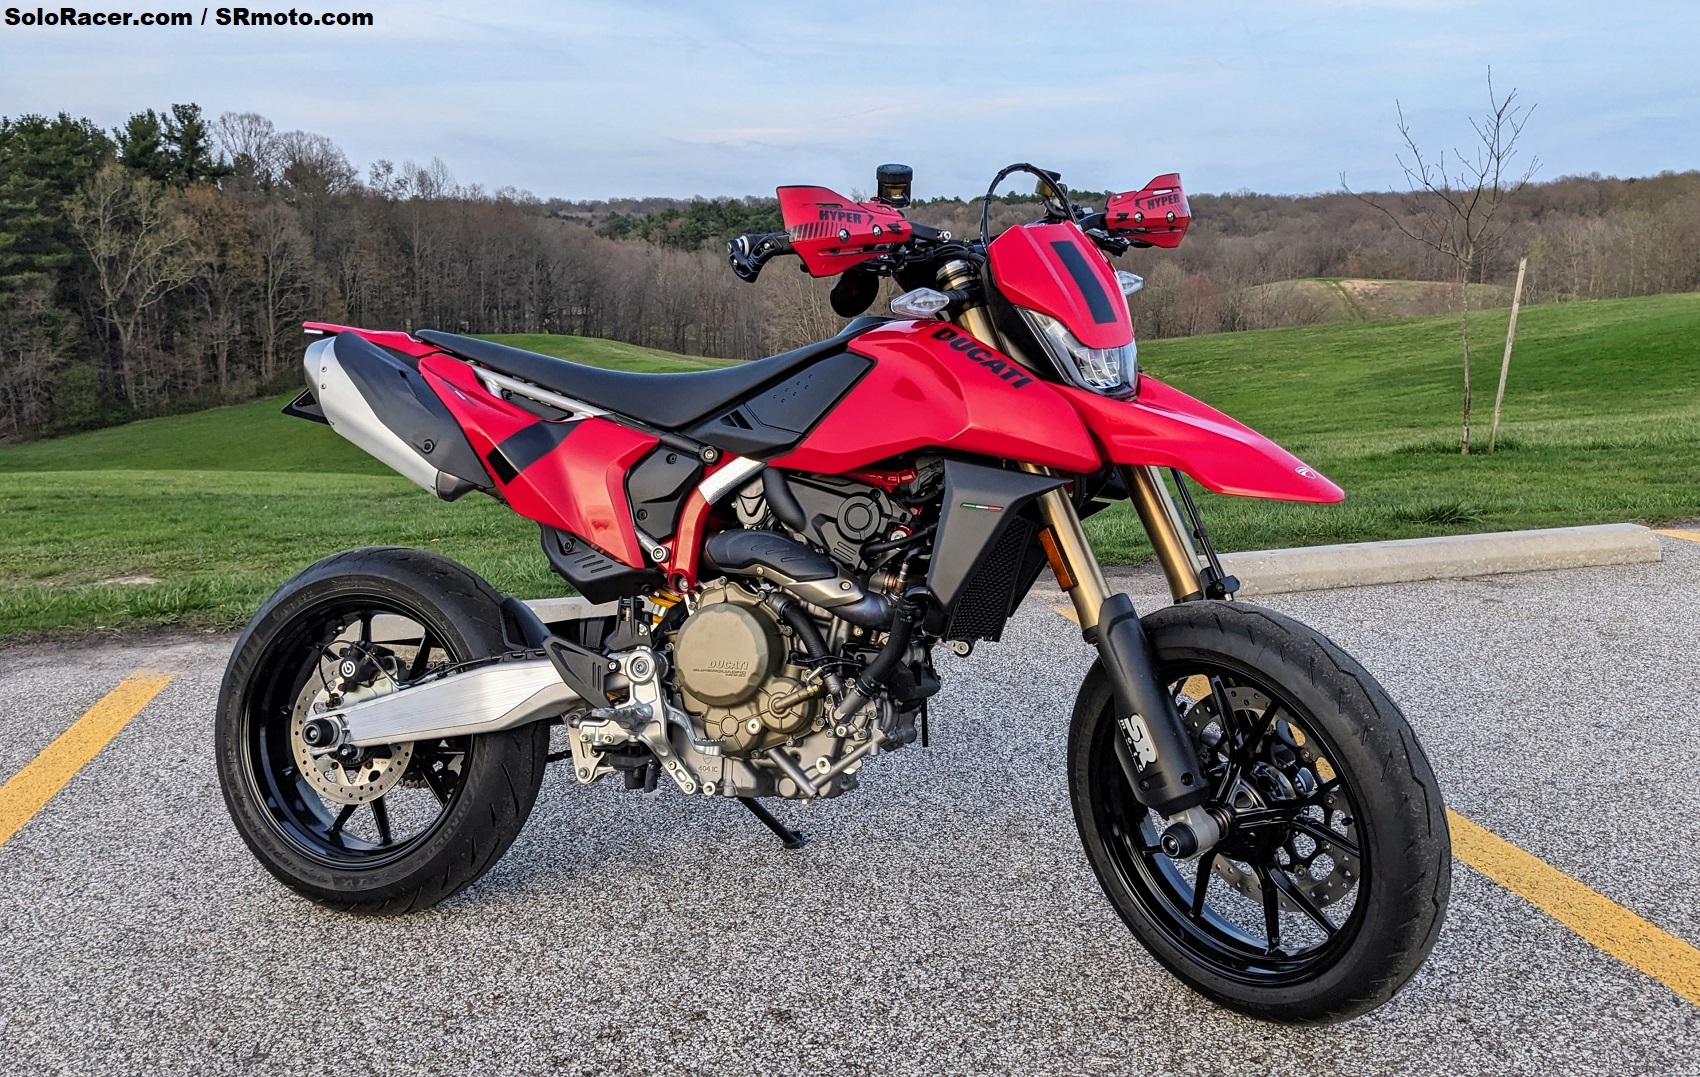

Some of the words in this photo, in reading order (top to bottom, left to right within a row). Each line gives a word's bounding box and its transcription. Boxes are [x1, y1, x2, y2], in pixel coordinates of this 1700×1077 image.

[1147, 193, 1180, 210] HYPER
[819, 210, 862, 224] HYPER
[931, 327, 1033, 389] DUCATI
[708, 660, 749, 670] DUCATI
[1123, 714, 1157, 769] SR
